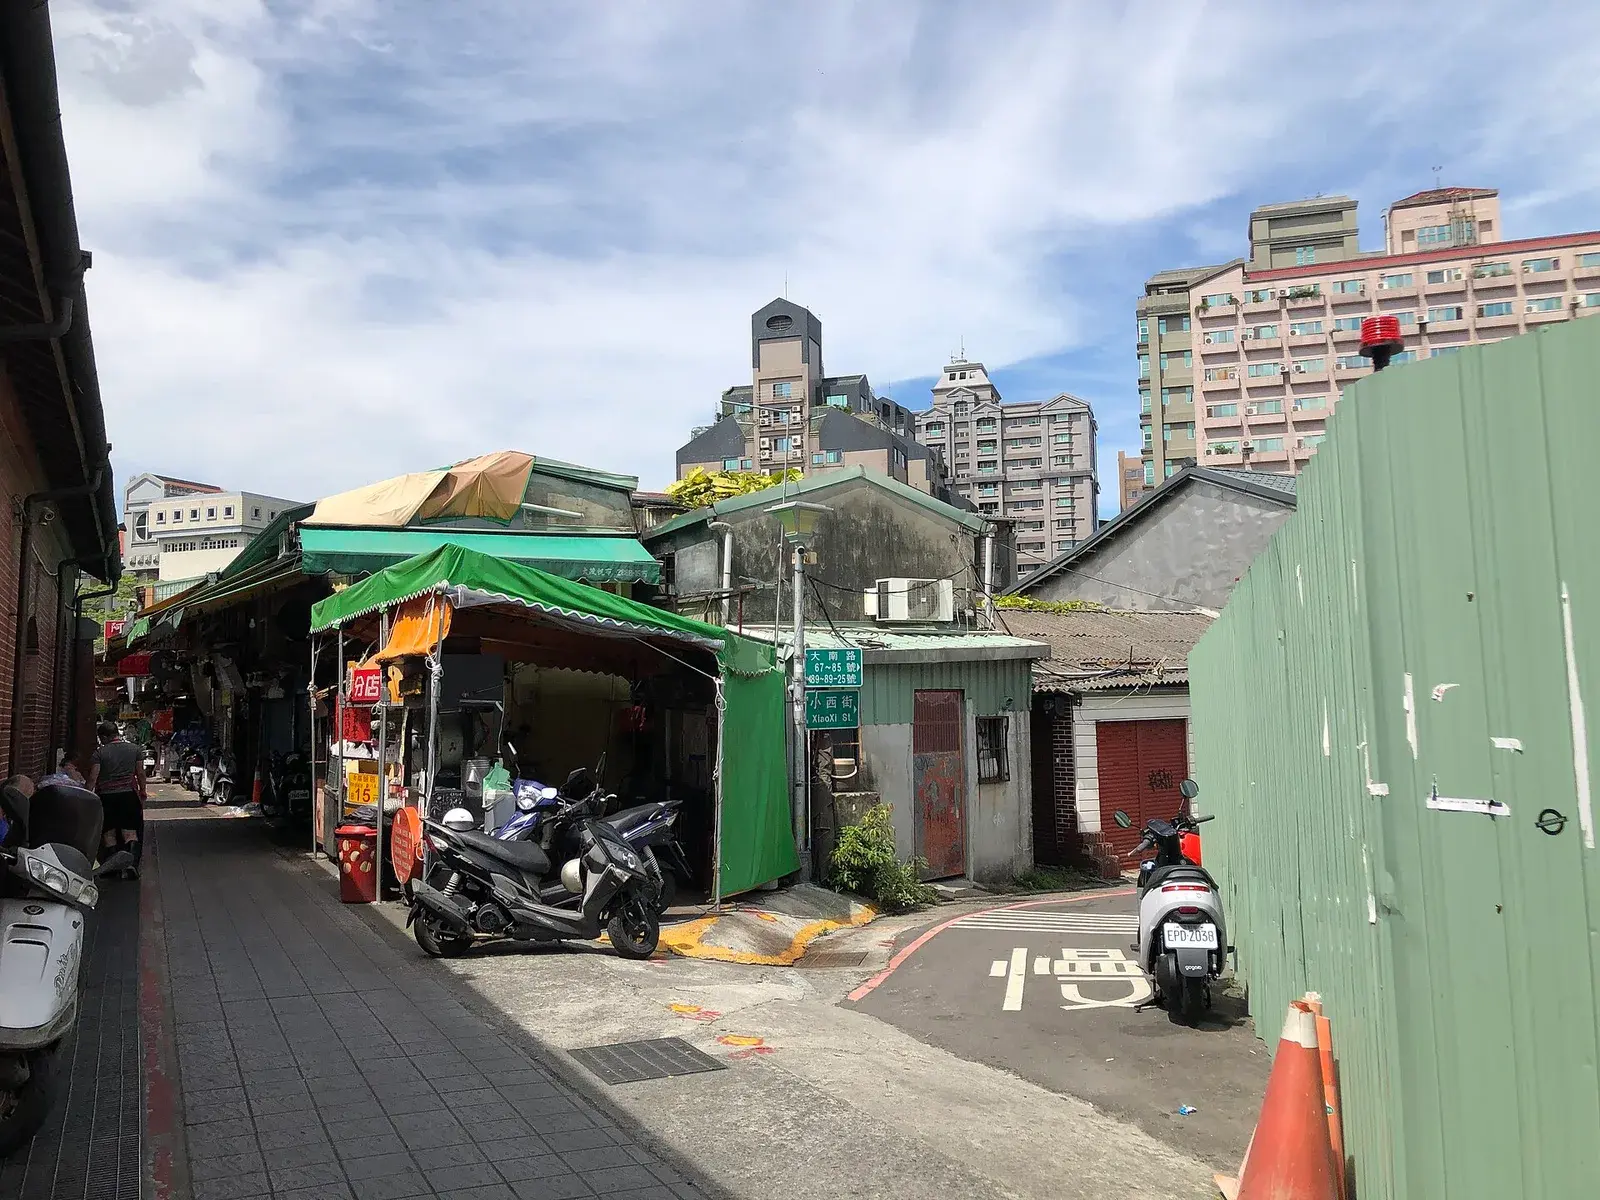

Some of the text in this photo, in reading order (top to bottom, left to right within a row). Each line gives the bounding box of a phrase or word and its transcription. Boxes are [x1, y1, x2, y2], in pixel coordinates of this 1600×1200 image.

[811, 651, 856, 661] 大南路
[810, 695, 852, 709] 小西街
[812, 713, 853, 723] XiaoXi St.
[355, 787, 371, 803] 15
[989, 947, 1154, 1012] 慢
